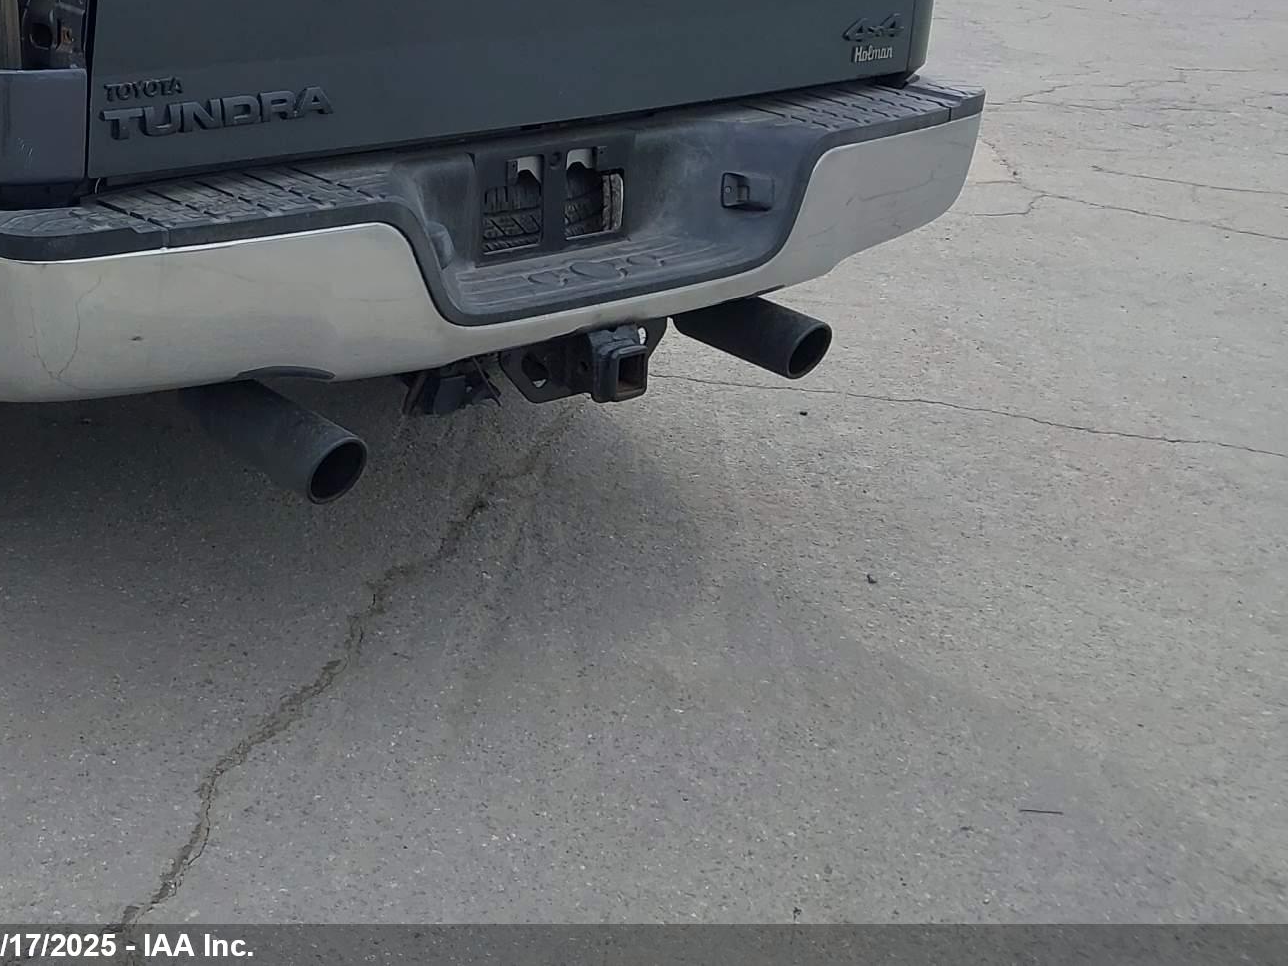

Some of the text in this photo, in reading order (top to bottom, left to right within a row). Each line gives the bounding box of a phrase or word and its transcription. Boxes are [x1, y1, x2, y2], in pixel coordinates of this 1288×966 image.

[852, 44, 893, 63] Holman
[103, 76, 184, 102] TOYOTA
[99, 85, 333, 140] TUNDRA
